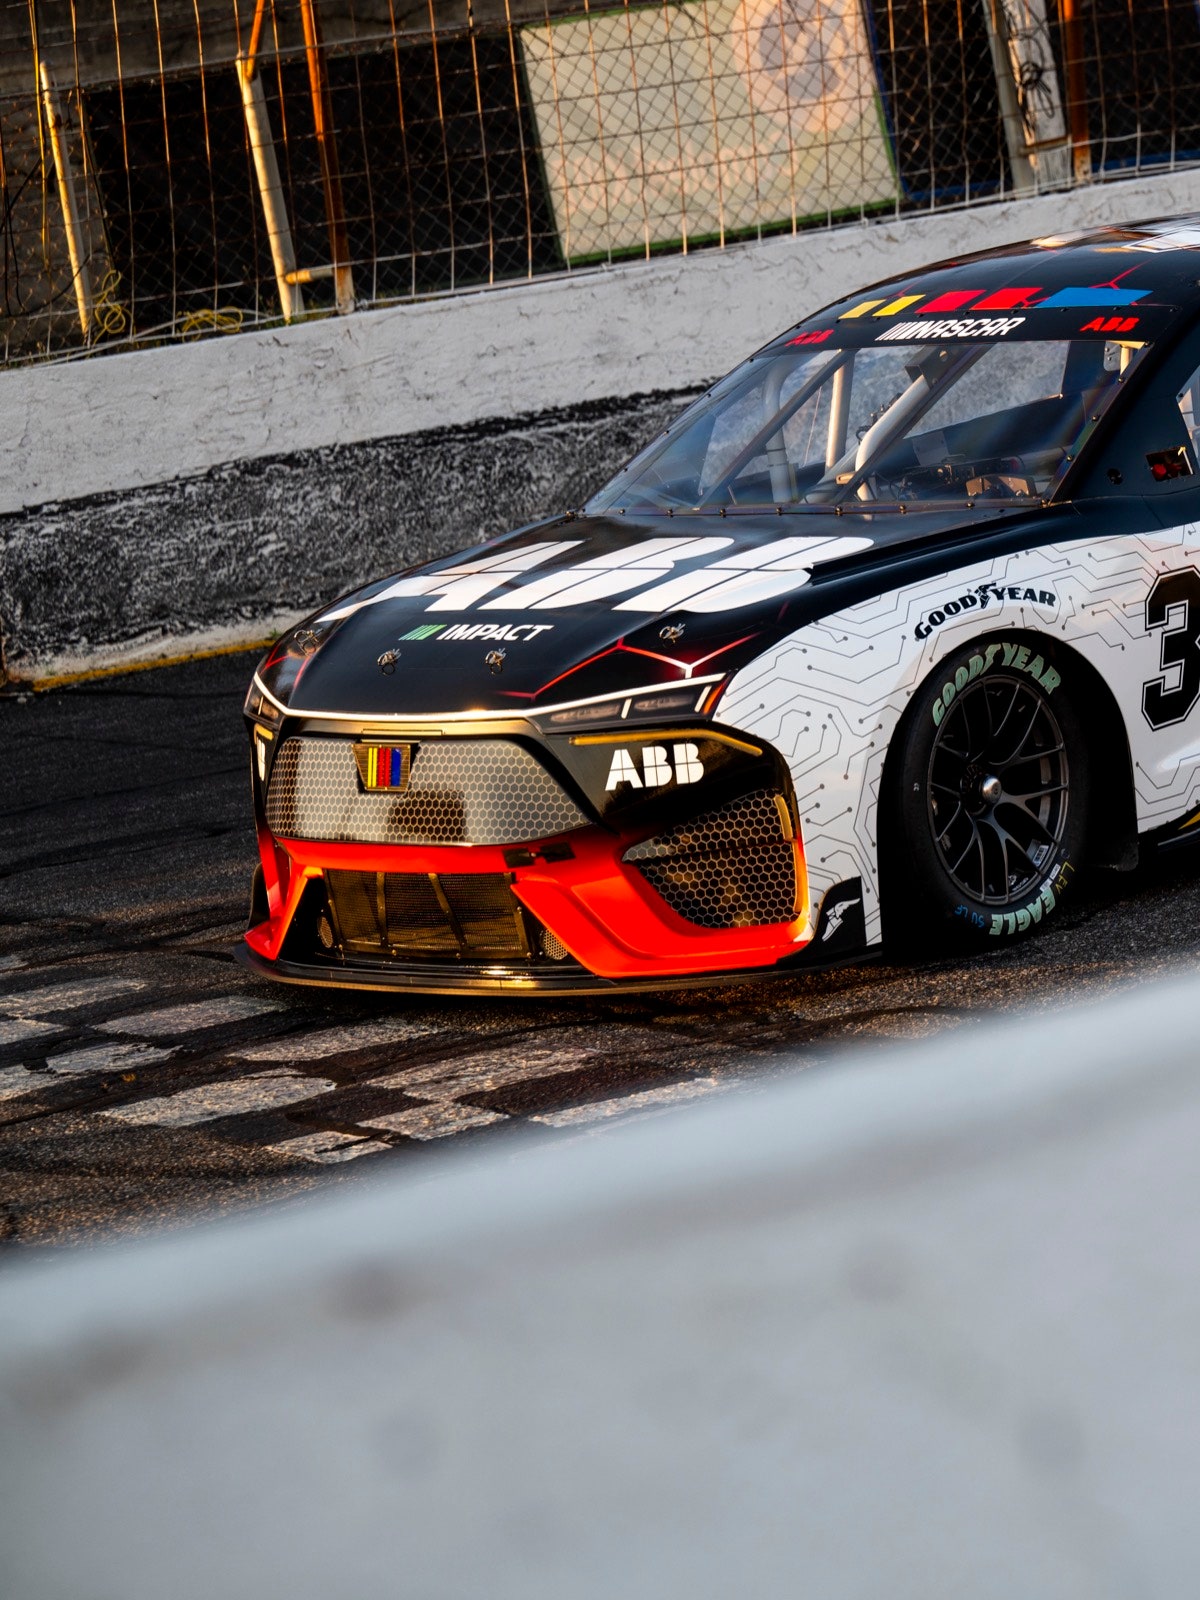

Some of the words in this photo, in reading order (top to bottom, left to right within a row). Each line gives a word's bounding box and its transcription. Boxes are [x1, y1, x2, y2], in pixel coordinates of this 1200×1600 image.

[902, 317, 1026, 340] NASCAR
[1079, 316, 1140, 333] ABB
[314, 536, 875, 614] ABB
[436, 624, 554, 642] IMPACT
[914, 582, 1057, 640] GOODYEAR
[932, 642, 1062, 727] GOODYEAR
[604, 742, 705, 792] ABB
[988, 885, 1056, 936] EAGLE
